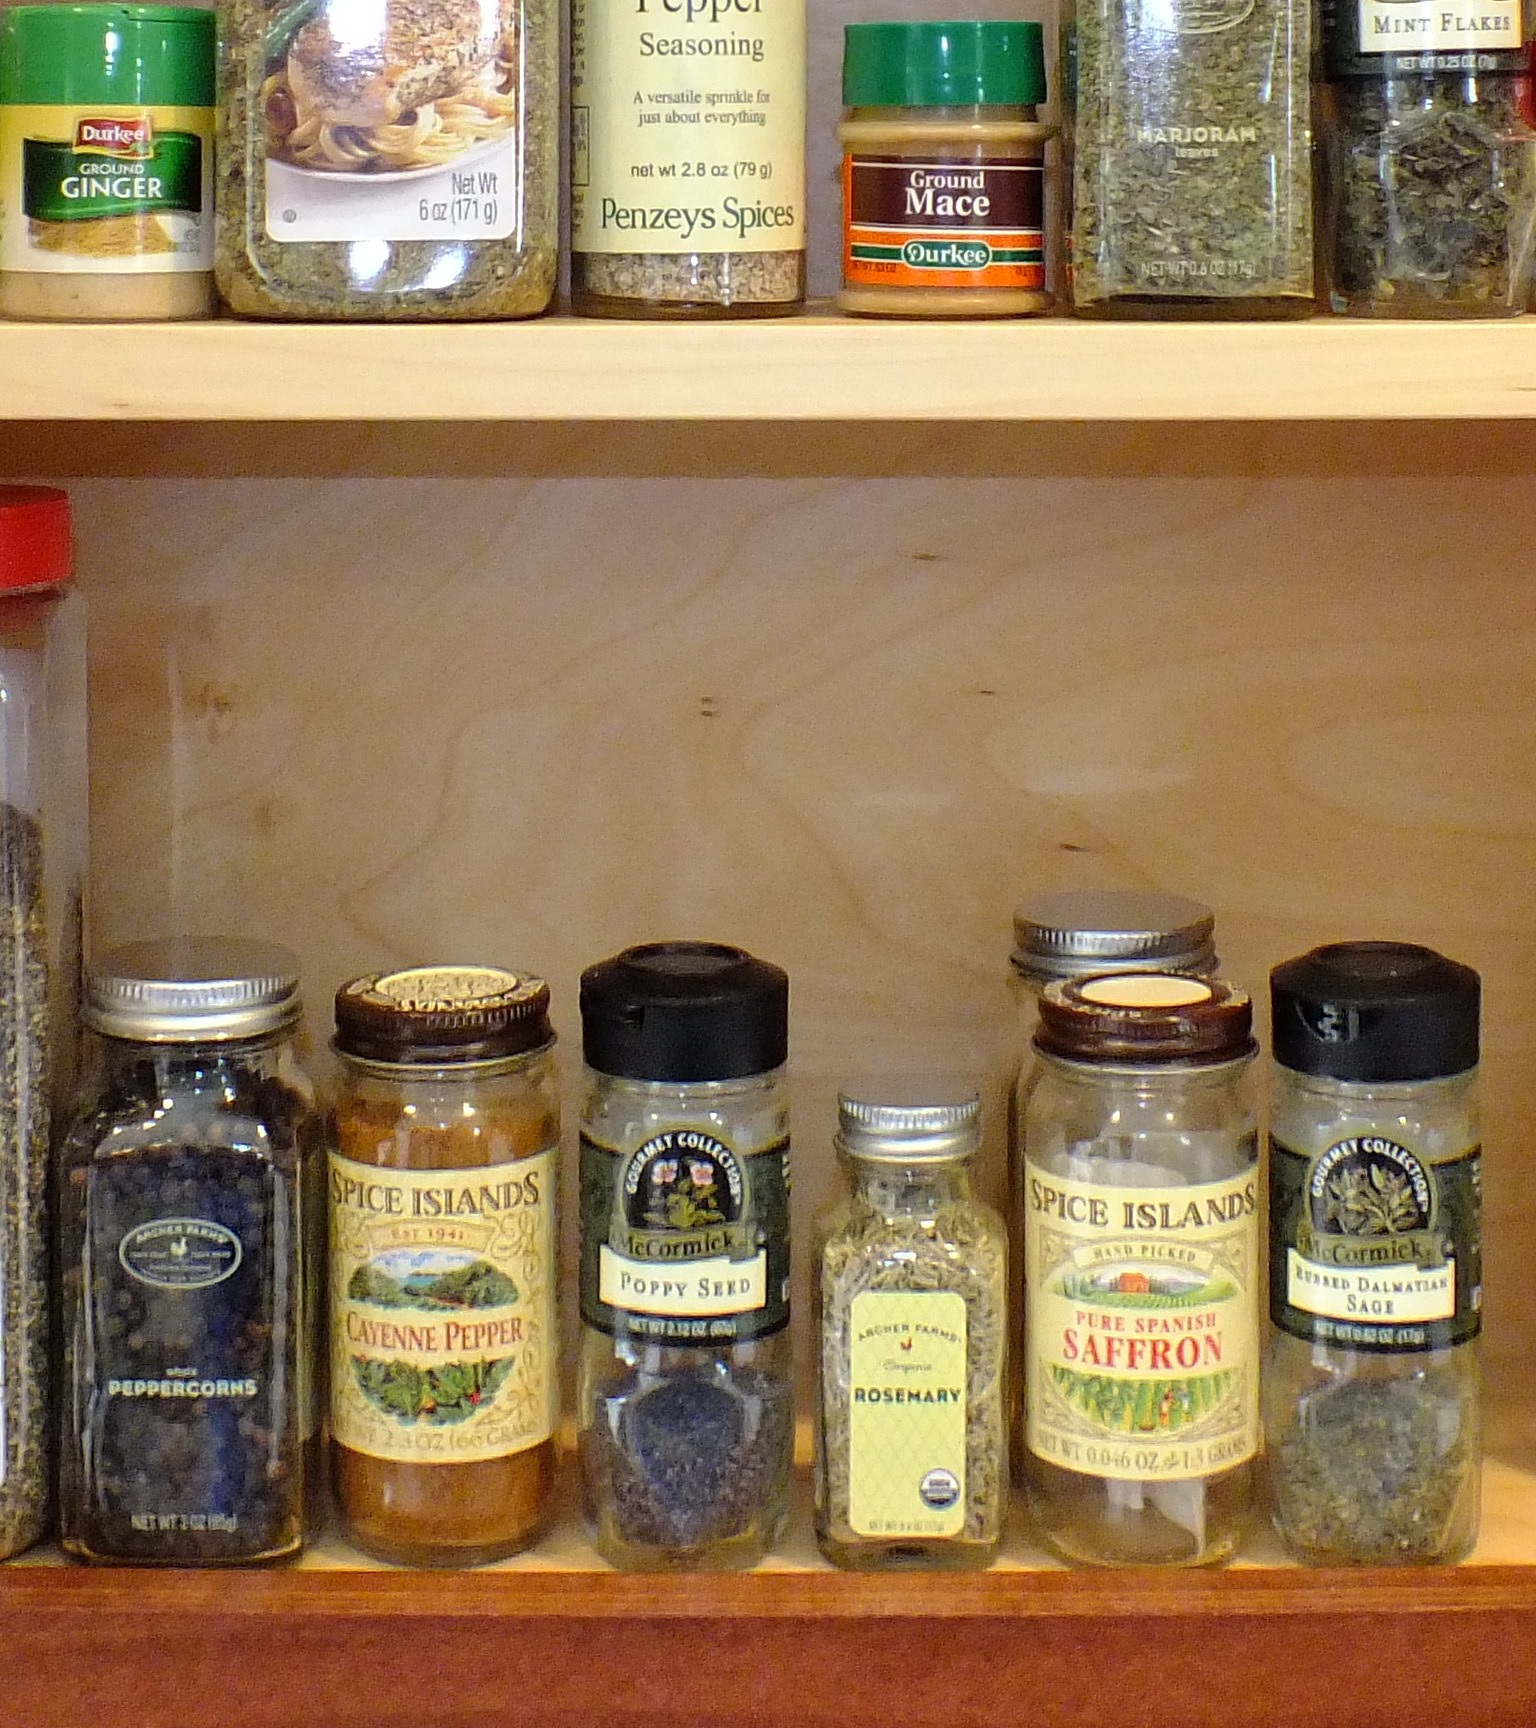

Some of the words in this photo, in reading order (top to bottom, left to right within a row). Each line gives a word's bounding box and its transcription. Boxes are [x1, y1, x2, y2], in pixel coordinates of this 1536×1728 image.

[1373, 14, 1432, 34] MINT
[639, 31, 765, 62] Seasoning
[647, 89, 702, 105] versatile
[705, 89, 754, 109] sprinkle
[637, 110, 662, 128] just
[665, 109, 701, 125] about
[83, 125, 145, 144] Durkee
[1136, 127, 1257, 144] MARJORAM
[79, 163, 145, 175] GROUND
[630, 163, 654, 178] net
[910, 170, 985, 189] Ground
[61, 177, 163, 199] GINGER
[451, 172, 477, 196] Net
[904, 187, 991, 217] Mace
[600, 197, 717, 239] Penzeys
[722, 196, 796, 239] Spices
[906, 243, 988, 266] Durkee
[331, 1171, 403, 1214] SPICE
[413, 1172, 540, 1217] ISLANDS
[1031, 1178, 1109, 1228] SPICE
[1123, 1182, 1256, 1230] ISLANDS
[1346, 1294, 1395, 1315] SAGE
[345, 1310, 439, 1351] CAYENNE
[443, 1317, 523, 1352] PEPPER
[1076, 1310, 1126, 1332] PURE
[1134, 1313, 1218, 1333] SPANISH
[1062, 1329, 1224, 1371] SAFFRON
[108, 1379, 258, 1398] PEPPERCORNS
[854, 1387, 962, 1404] ROSEMARY
